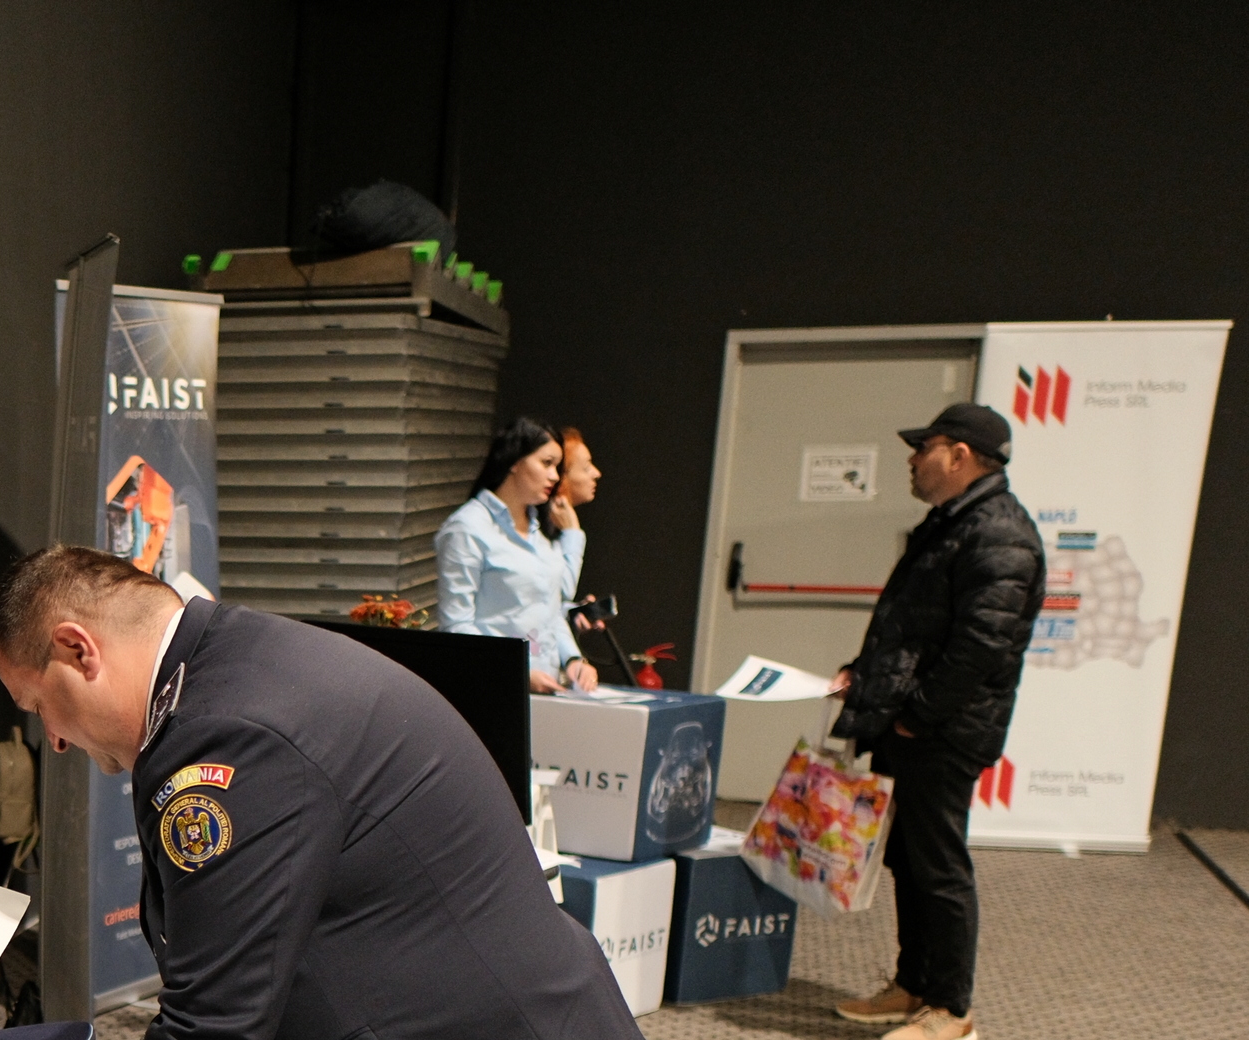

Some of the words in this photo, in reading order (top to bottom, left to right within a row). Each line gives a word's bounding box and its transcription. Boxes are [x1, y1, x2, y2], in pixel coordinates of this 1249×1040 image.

[122, 376, 207, 410] FAIST
[549, 766, 629, 792] AIST
[724, 913, 791, 939] FAIST
[618, 928, 666, 958] FAIST
